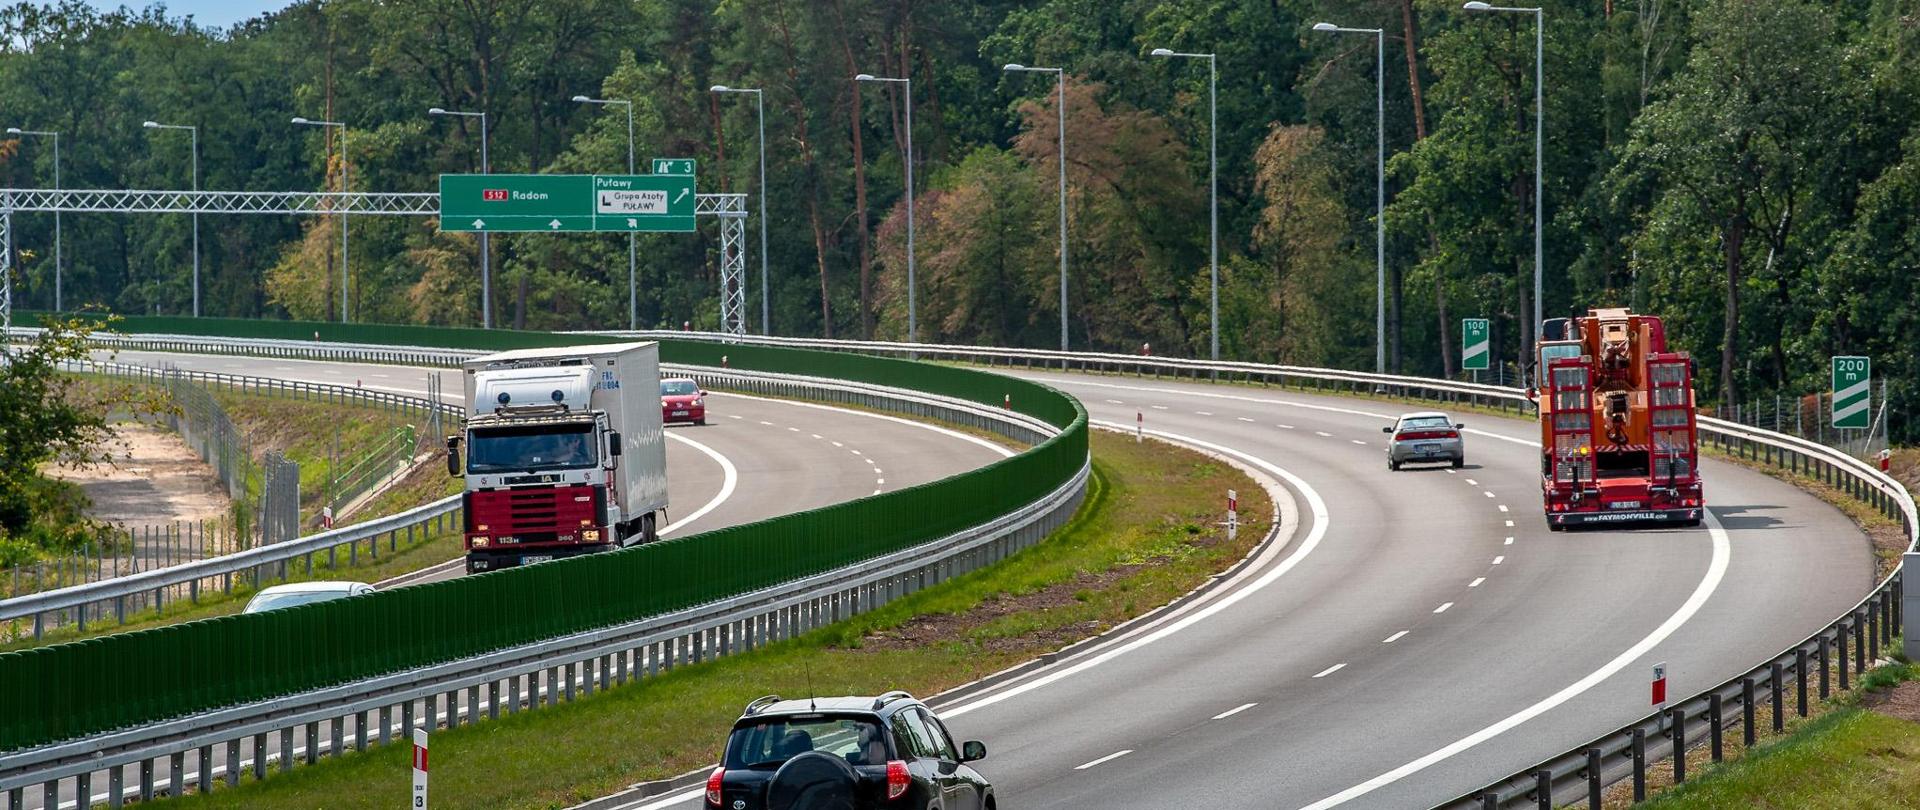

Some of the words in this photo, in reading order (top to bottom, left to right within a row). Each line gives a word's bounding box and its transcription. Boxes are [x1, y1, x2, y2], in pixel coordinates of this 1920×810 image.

[684, 162, 691, 173] 3
[597, 178, 632, 189] Puławy
[512, 190, 548, 200] Radom
[614, 192, 640, 201] Grupa
[641, 192, 664, 201] Azoty
[623, 202, 655, 210] PUŁAWY
[1467, 321, 1484, 330] 100
[1838, 360, 1864, 371] 200
[1845, 372, 1857, 380] m
[415, 795, 424, 808] 3
